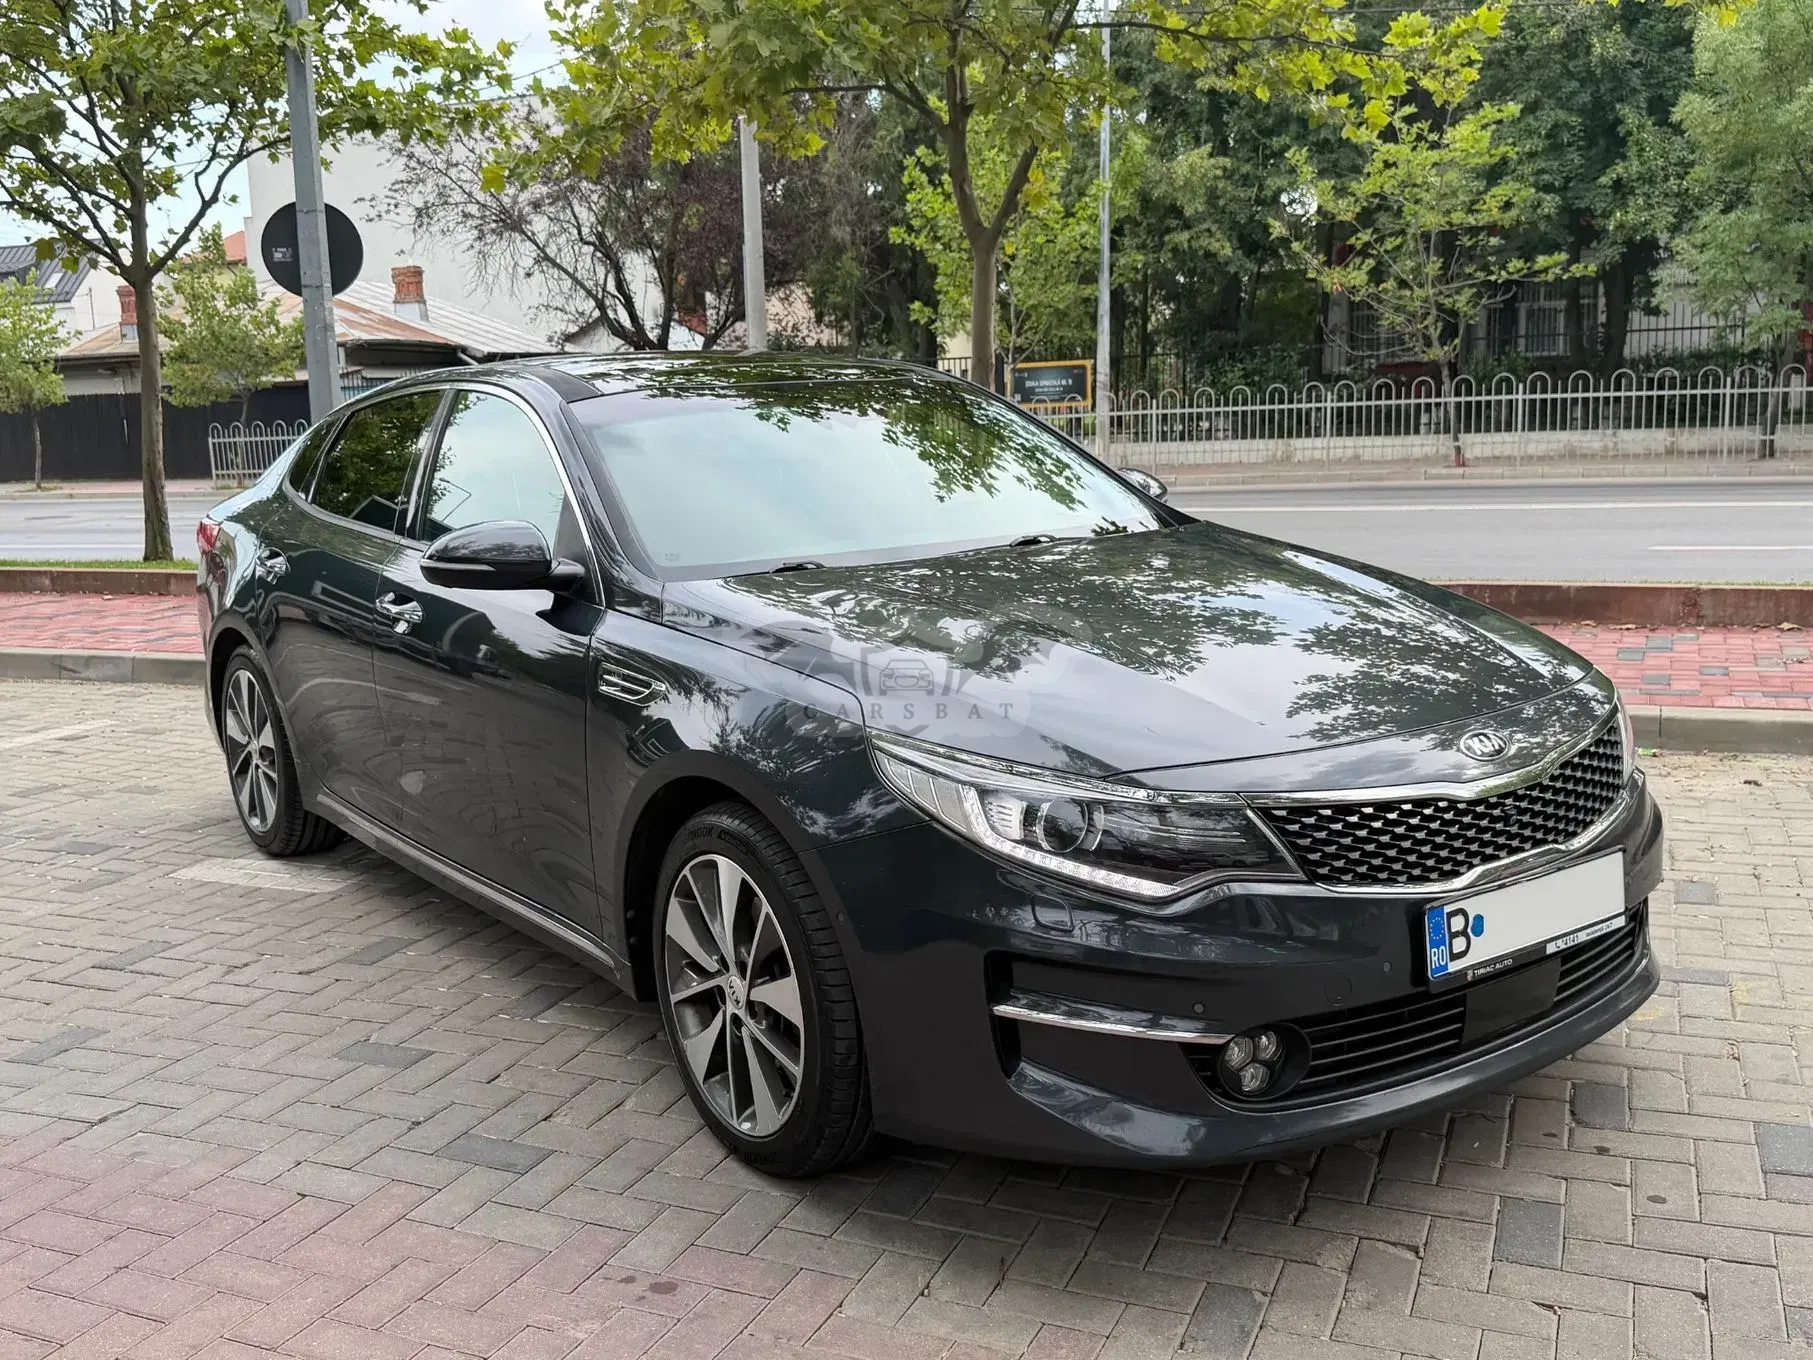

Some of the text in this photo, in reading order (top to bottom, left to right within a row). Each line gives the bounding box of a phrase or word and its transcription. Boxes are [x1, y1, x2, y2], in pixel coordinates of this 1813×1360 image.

[1465, 733, 1506, 756] KIA
[1446, 907, 1471, 962] B
[1431, 945, 1447, 969] RO
[1474, 958, 1513, 977] TIRIAC AUTO
